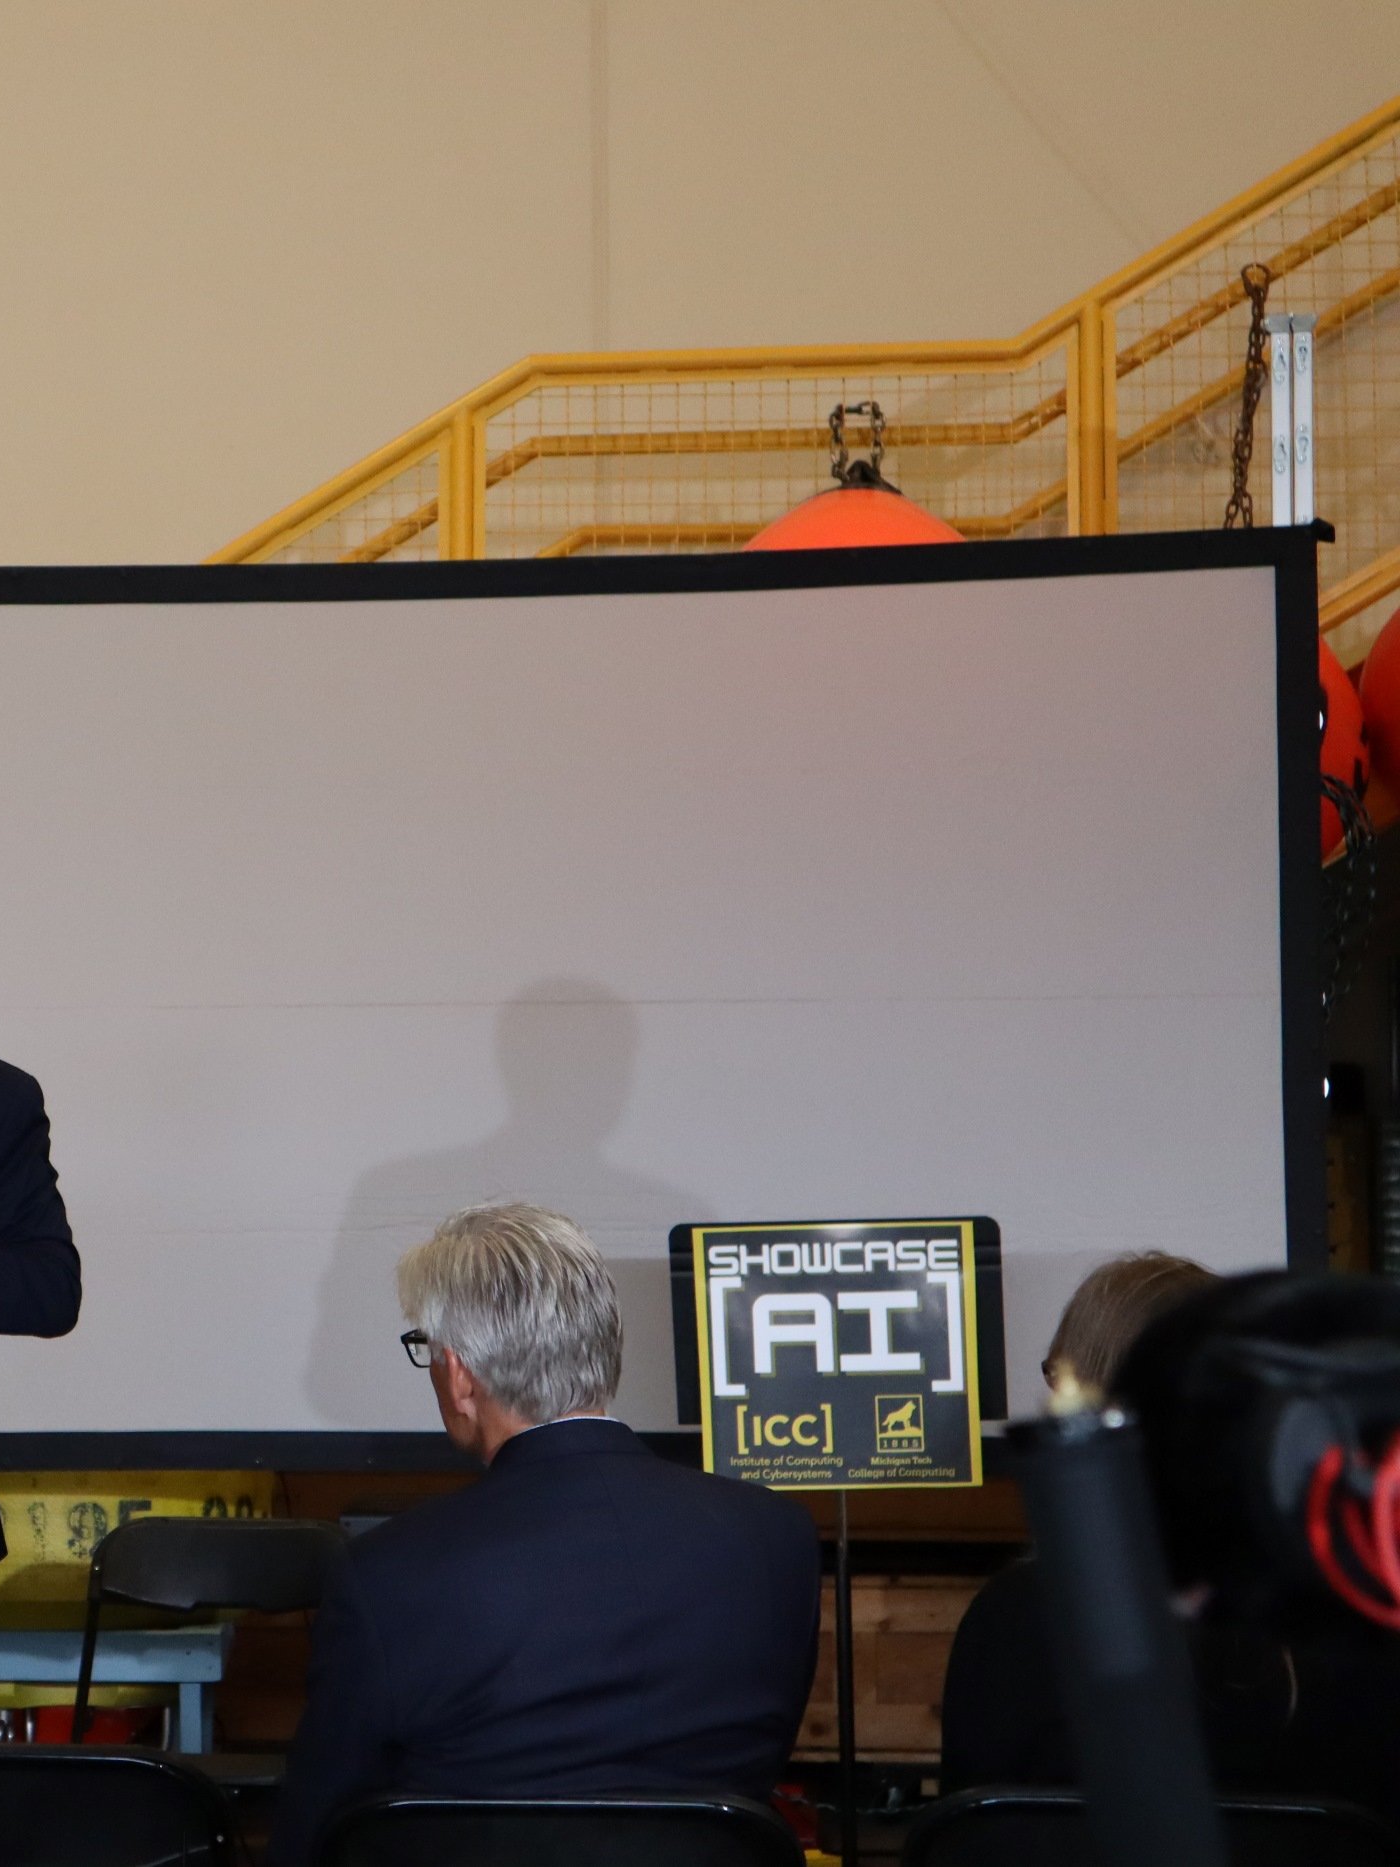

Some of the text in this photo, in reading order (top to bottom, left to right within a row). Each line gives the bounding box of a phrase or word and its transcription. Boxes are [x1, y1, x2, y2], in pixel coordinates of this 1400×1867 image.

[708, 1239, 959, 1275] SHOWCASE
[730, 1455, 844, 1468] Institute of Computing
[870, 1456, 933, 1466] Michigan Tech
[741, 1468, 833, 1481] and Cybersystems
[848, 1467, 956, 1479] College of Computing
